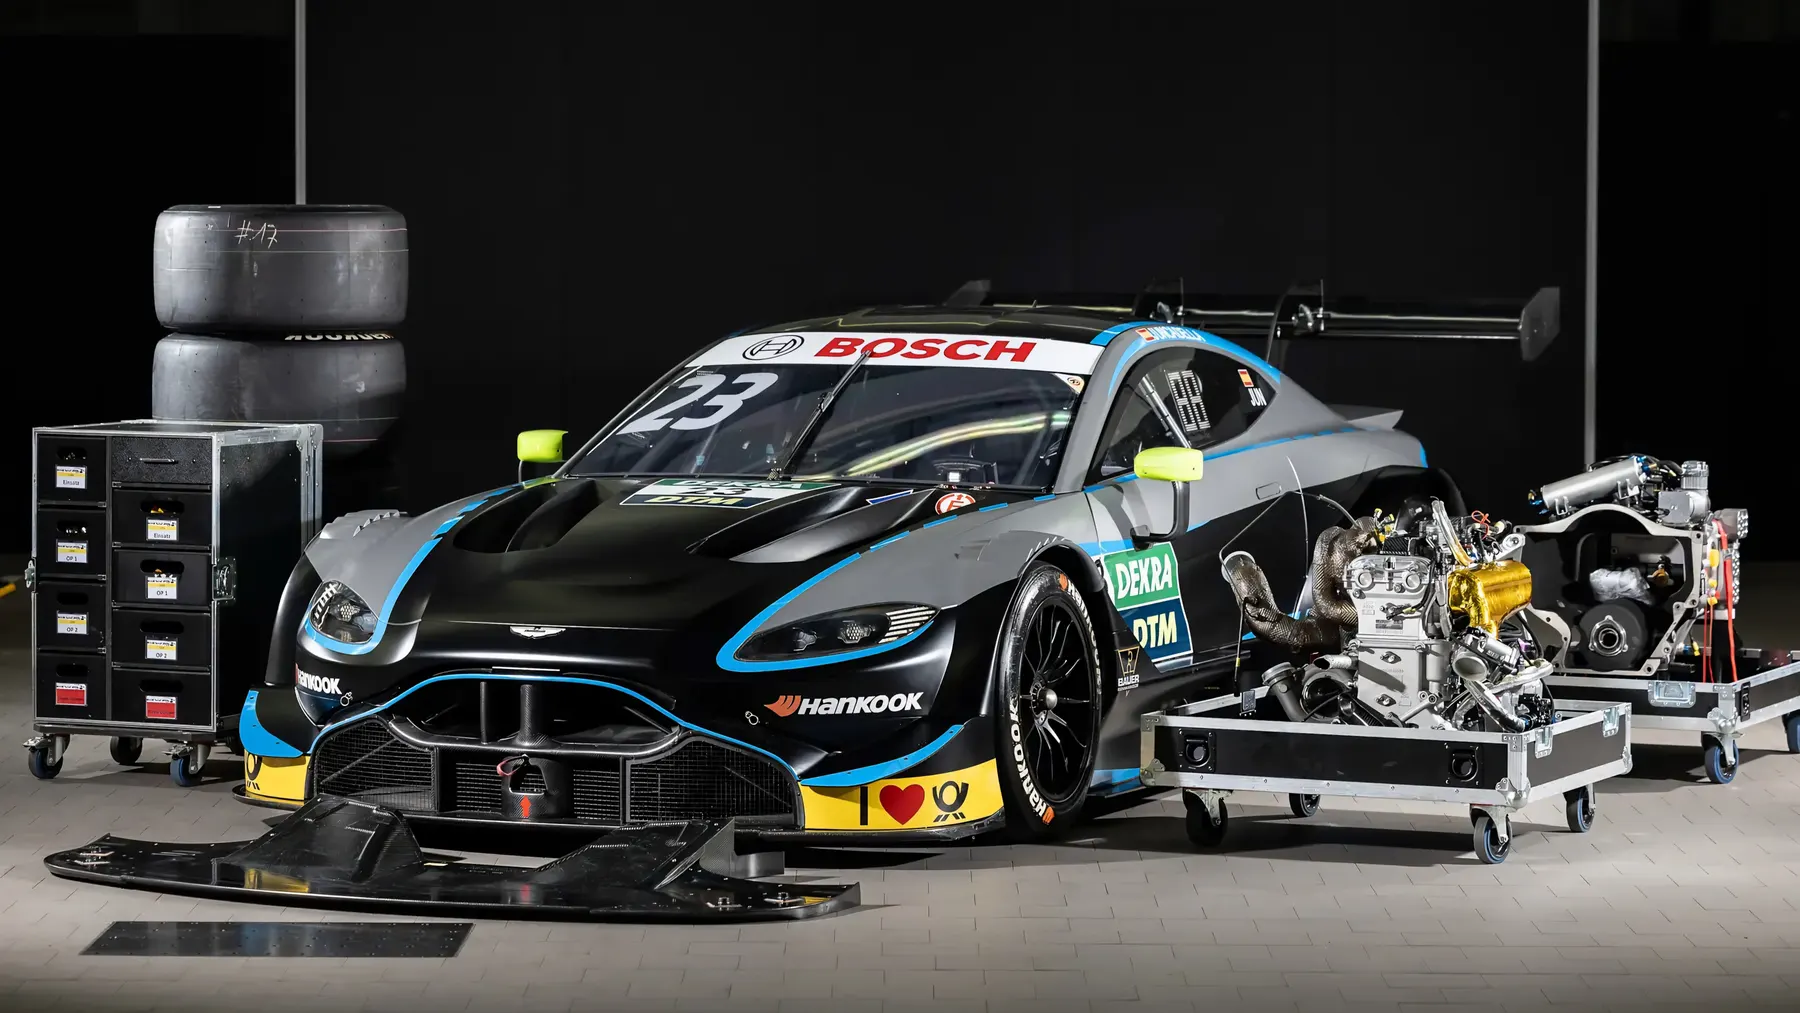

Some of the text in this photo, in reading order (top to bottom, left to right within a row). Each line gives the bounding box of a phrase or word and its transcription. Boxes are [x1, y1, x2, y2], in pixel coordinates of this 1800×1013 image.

[814, 337, 1037, 362] BOSCH
[615, 372, 779, 435] 23
[1248, 388, 1267, 407] JUN
[643, 496, 744, 506] DTM
[1115, 553, 1173, 600] DEKRA
[1133, 611, 1178, 649] DTM
[1117, 674, 1140, 687] BAUER
